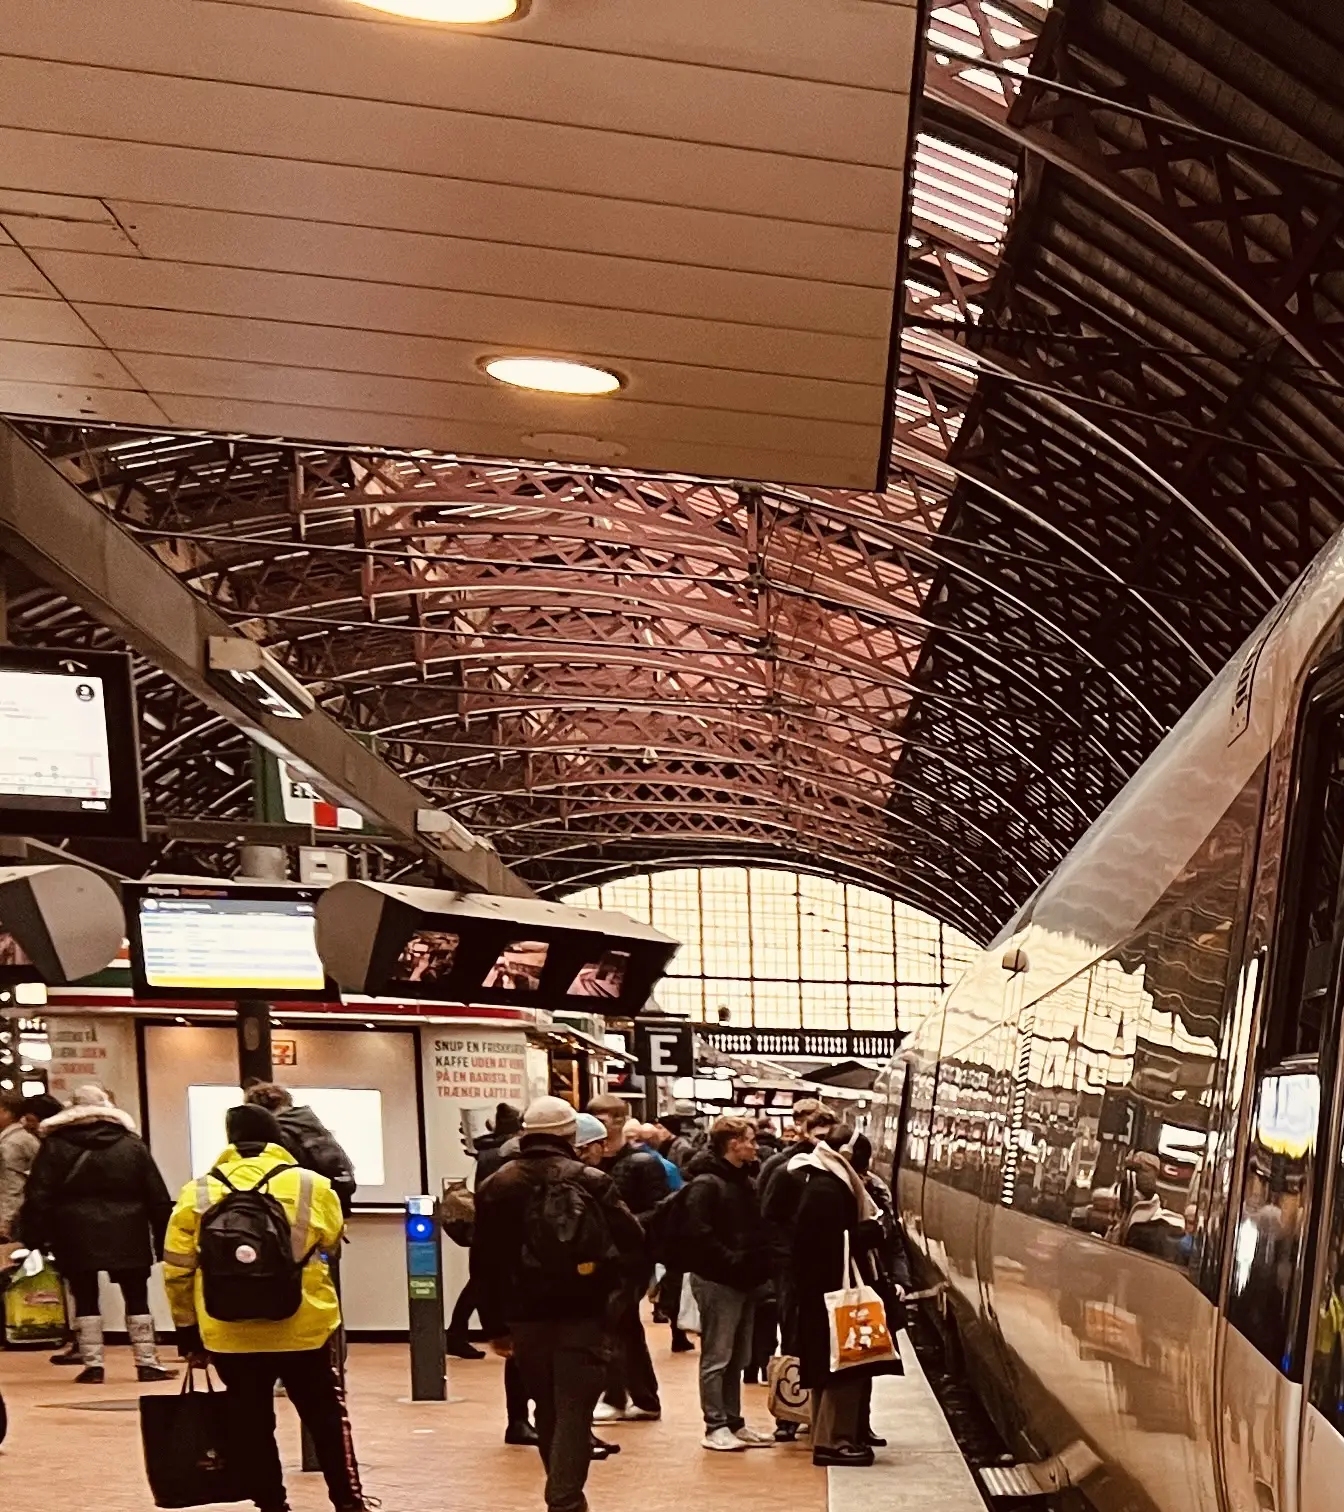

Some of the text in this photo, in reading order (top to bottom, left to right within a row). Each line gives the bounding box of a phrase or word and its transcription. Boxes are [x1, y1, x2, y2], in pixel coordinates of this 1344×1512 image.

[435, 1040, 463, 1052] SNUP
[466, 1042, 479, 1053] EN
[650, 1034, 678, 1073] E
[435, 1056, 469, 1068] KAFFE
[436, 1068, 451, 1082] PÅ
[453, 1071, 466, 1082] EN
